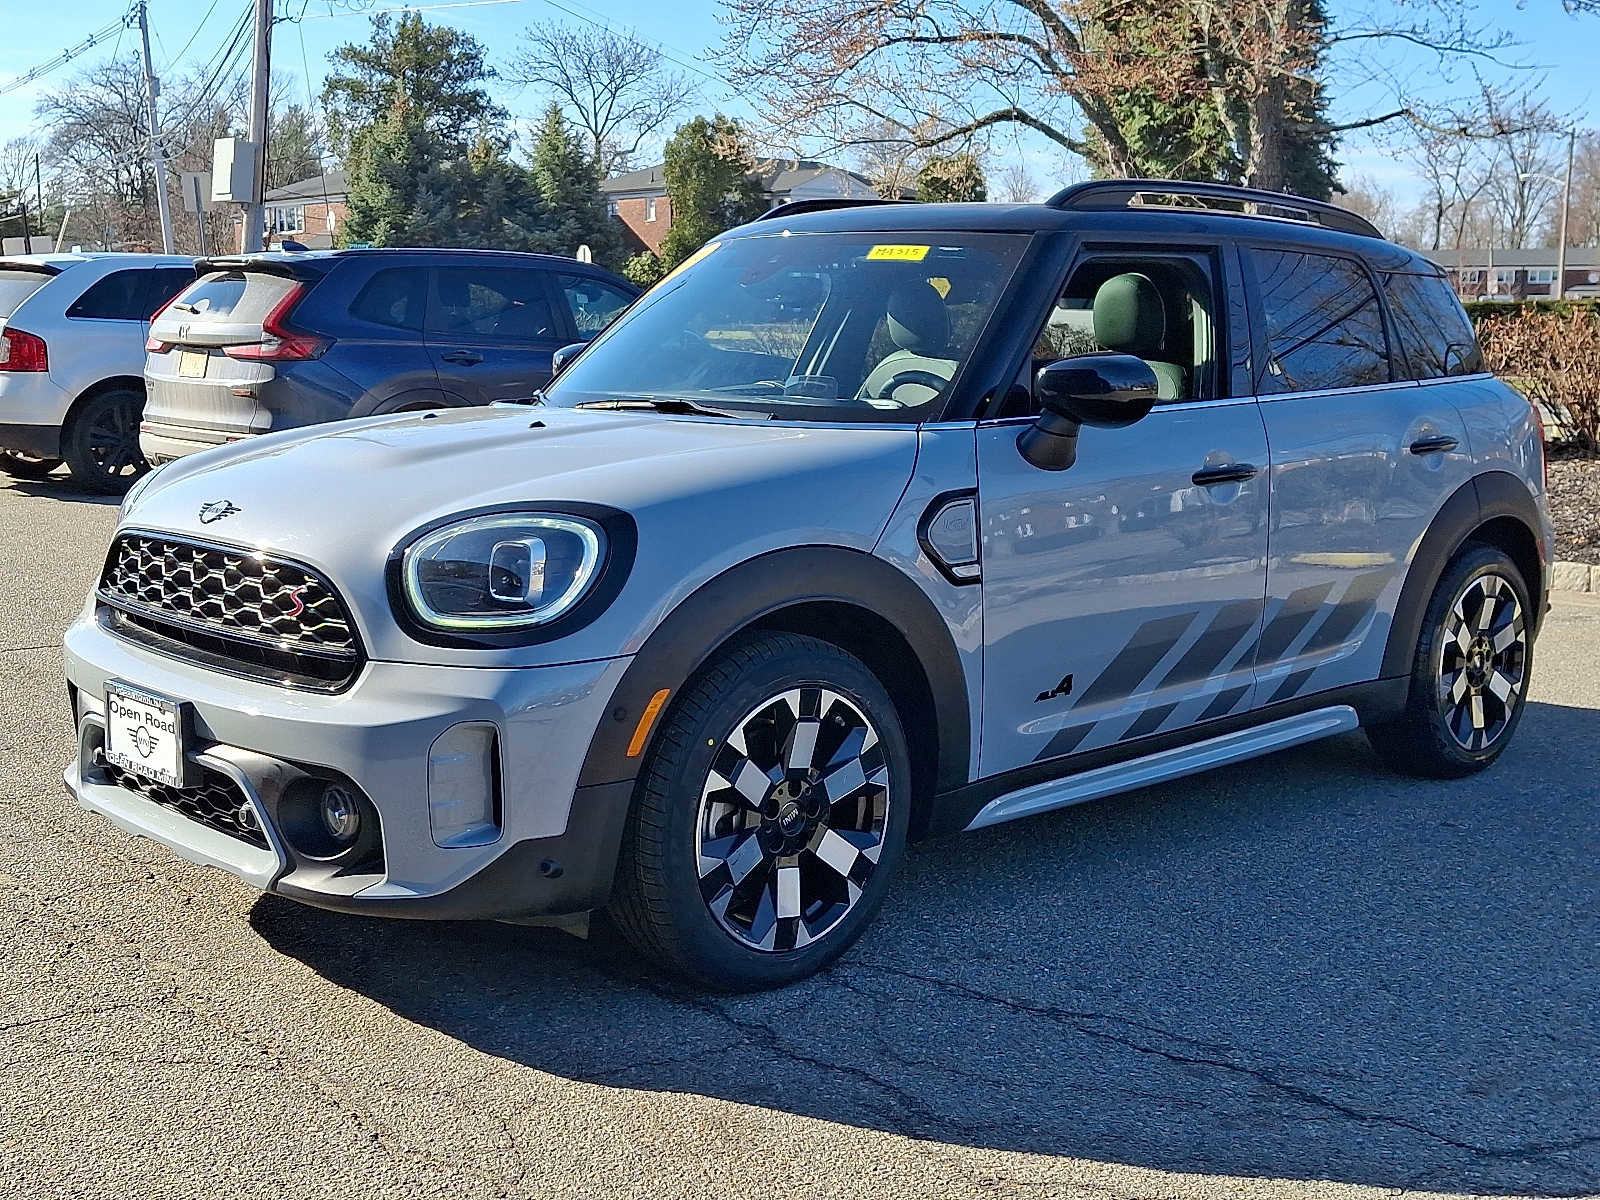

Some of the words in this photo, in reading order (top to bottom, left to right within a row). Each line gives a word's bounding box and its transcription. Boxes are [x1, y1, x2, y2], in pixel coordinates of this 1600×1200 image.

[109, 701, 141, 722] Open
[145, 712, 175, 735] Road
[783, 808, 798, 826] MINI
